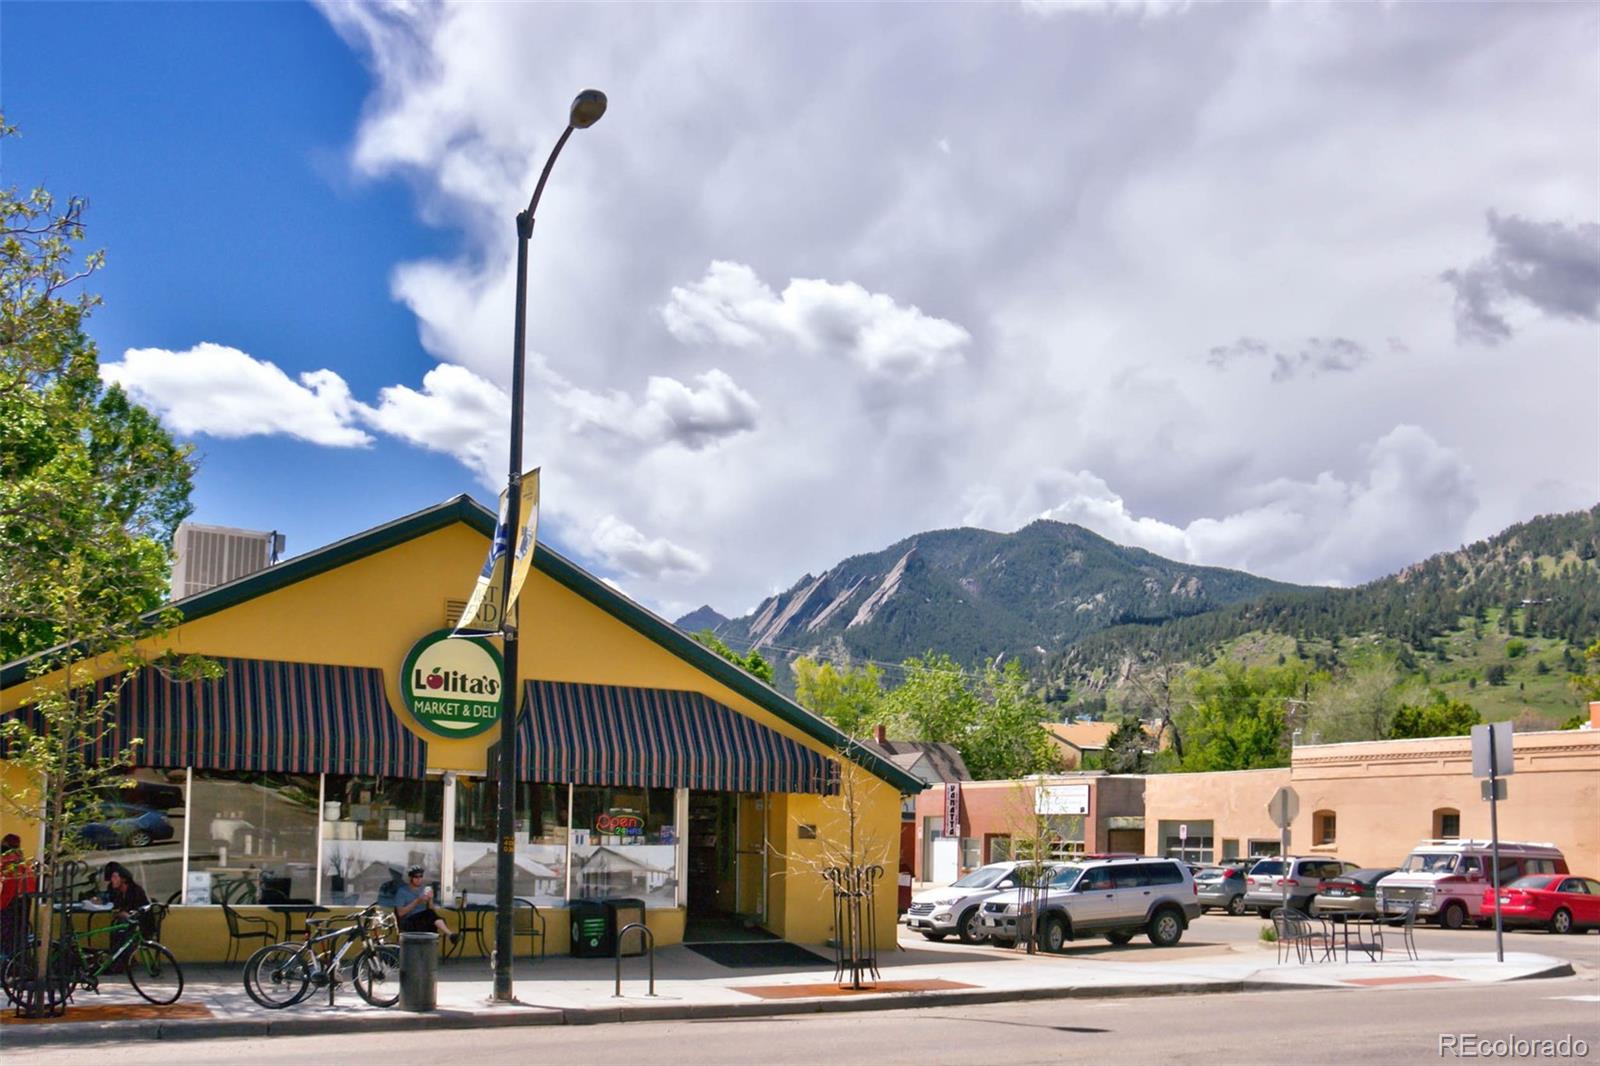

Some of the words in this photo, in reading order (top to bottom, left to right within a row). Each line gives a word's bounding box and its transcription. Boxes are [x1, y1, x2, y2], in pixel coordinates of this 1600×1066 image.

[414, 667, 500, 695] Lolita's
[414, 700, 460, 716] MARKET
[463, 704, 471, 717] &
[473, 704, 497, 718] DELI
[597, 814, 637, 831] Open
